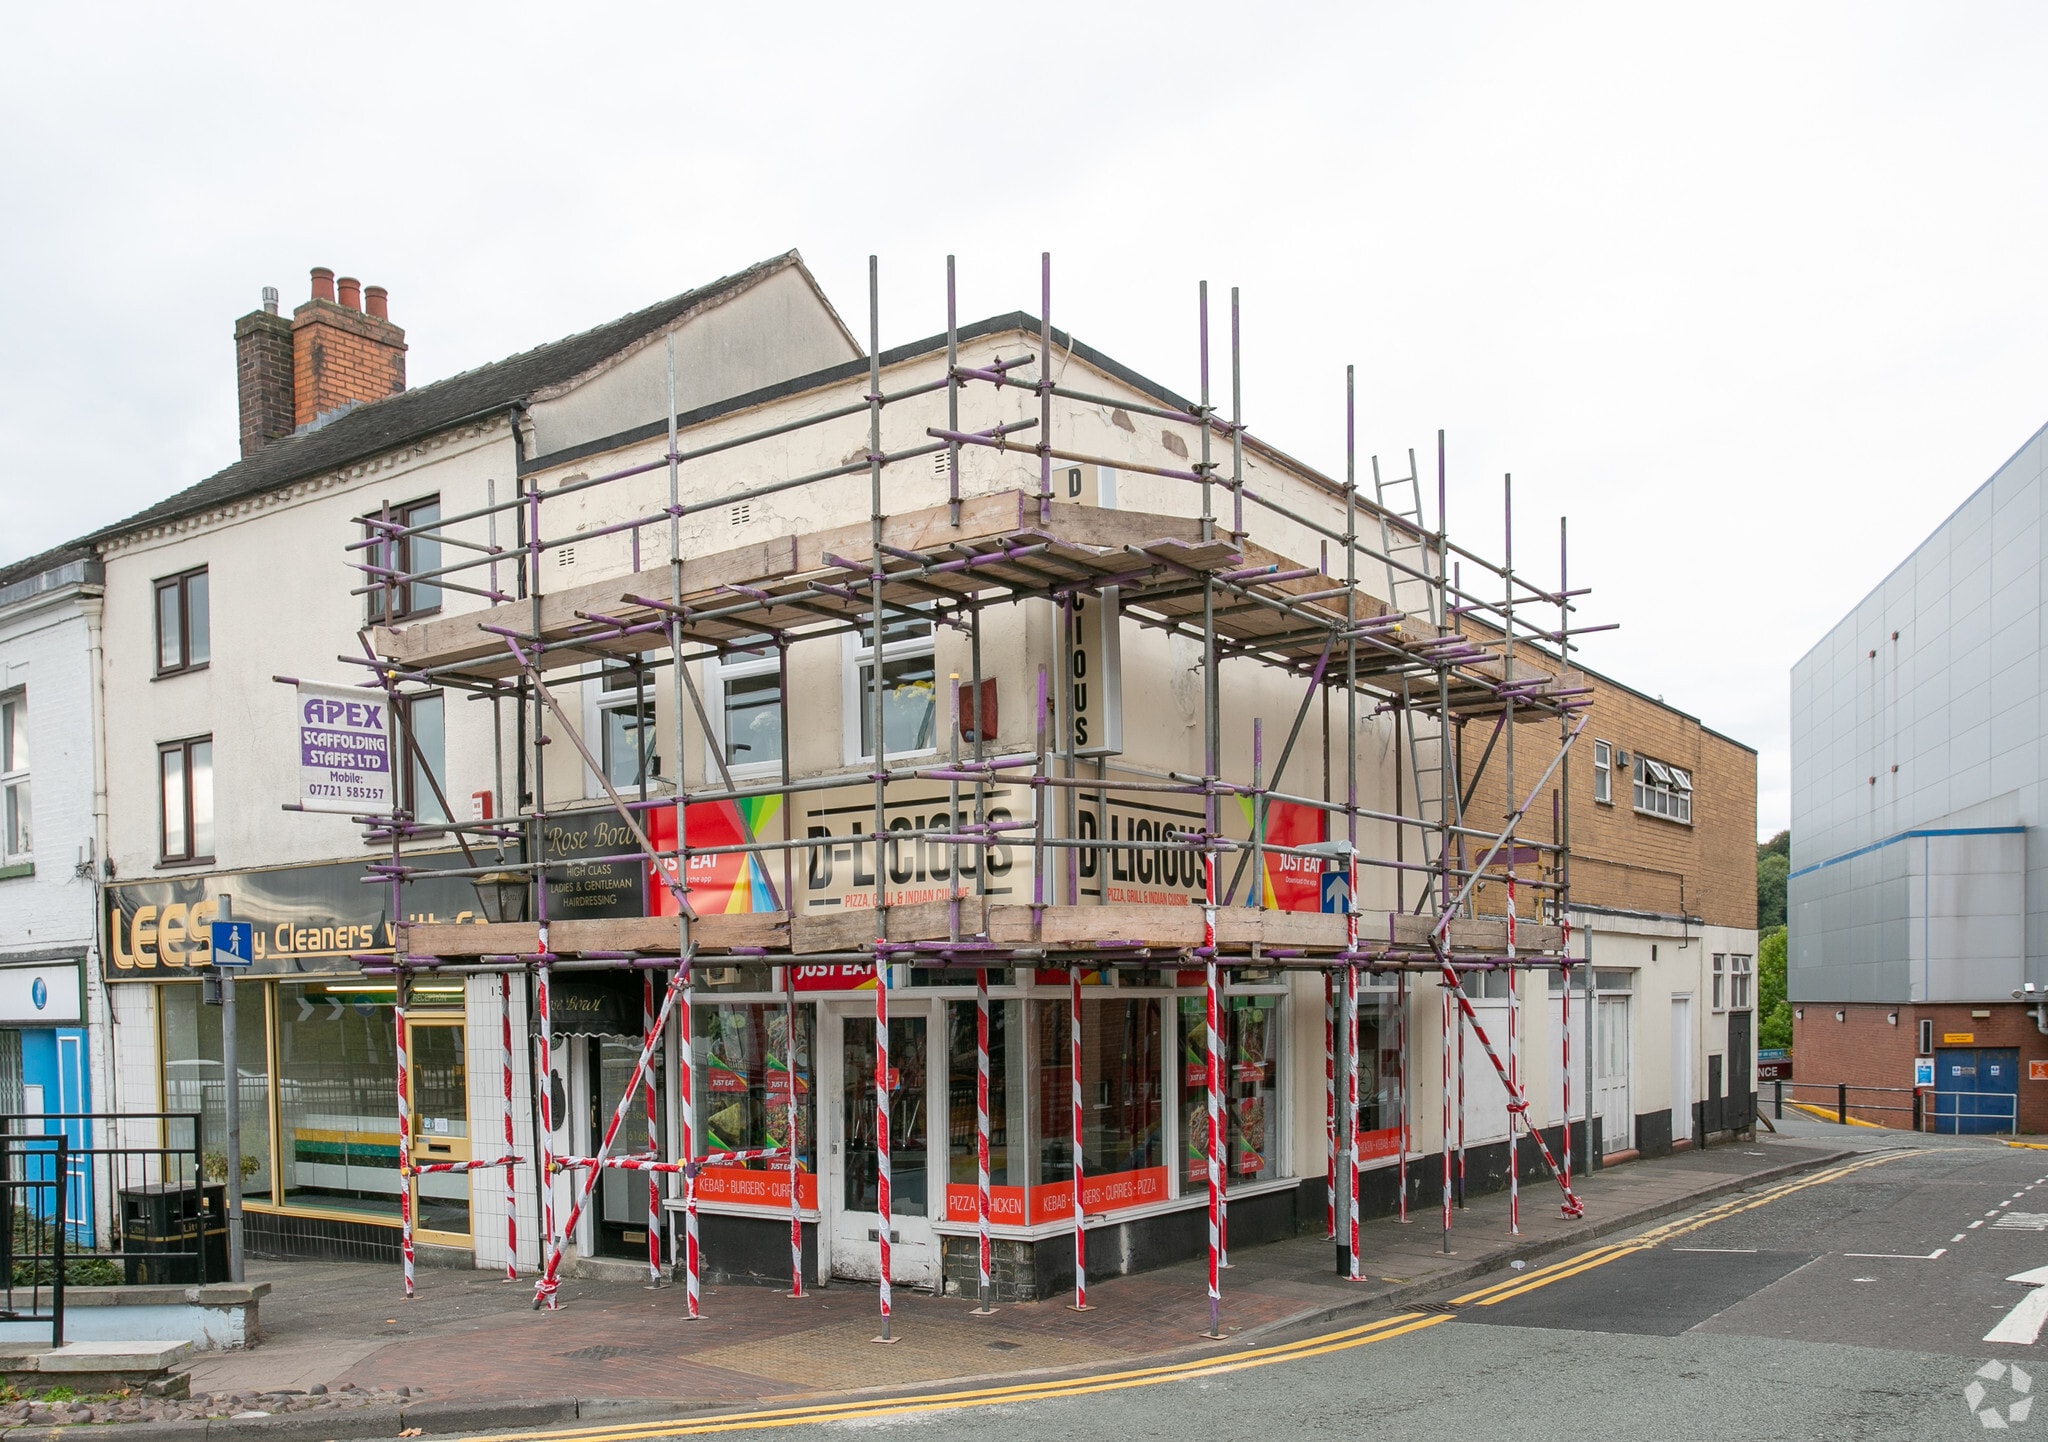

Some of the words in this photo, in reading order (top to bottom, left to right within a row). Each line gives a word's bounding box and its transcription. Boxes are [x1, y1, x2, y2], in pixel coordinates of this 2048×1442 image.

[304, 698, 383, 729] APEX
[303, 731, 385, 752] SCAFFOLDING
[310, 750, 355, 767] STAFFS
[357, 754, 381, 769] LTD
[330, 771, 363, 784] Mobile:
[309, 784, 342, 797] 07721
[346, 786, 384, 800] 585257
[548, 827, 588, 857] Rose
[807, 806, 1014, 890] D-LCIOUS
[566, 865, 586, 877] HIGH
[587, 864, 612, 876] CLASS
[1279, 854, 1302, 871] JUST
[1304, 857, 1322, 873] EAT
[550, 882, 574, 893] LADIES
[575, 881, 582, 891] &
[584, 878, 632, 892] GENTLEMAN
[701, 876, 712, 884] app
[563, 894, 617, 907] HAIRDRESSING
[845, 893, 871, 908] PIZZA,
[897, 891, 904, 905] &
[905, 889, 934, 904] INDIAN
[1107, 887, 1126, 904] PIZZA,
[1126, 889, 1143, 904] GRILL
[1143, 891, 1148, 904] &
[1149, 891, 1168, 905] INDIAN
[1168, 893, 1188, 906] CUISINE
[111, 900, 218, 970] LEES
[274, 922, 373, 952] Cleaners
[566, 995, 607, 1012] Bowl
[699, 1178, 725, 1193] KEBAB
[731, 1179, 765, 1196] BURGERS
[1043, 1196, 1066, 1212] KEBAB
[1105, 1181, 1133, 1200] CURRIES
[1137, 1178, 1157, 1194] PIZZA
[949, 1196, 977, 1210] PIZZA
[988, 1197, 1022, 1214] HICKEN
